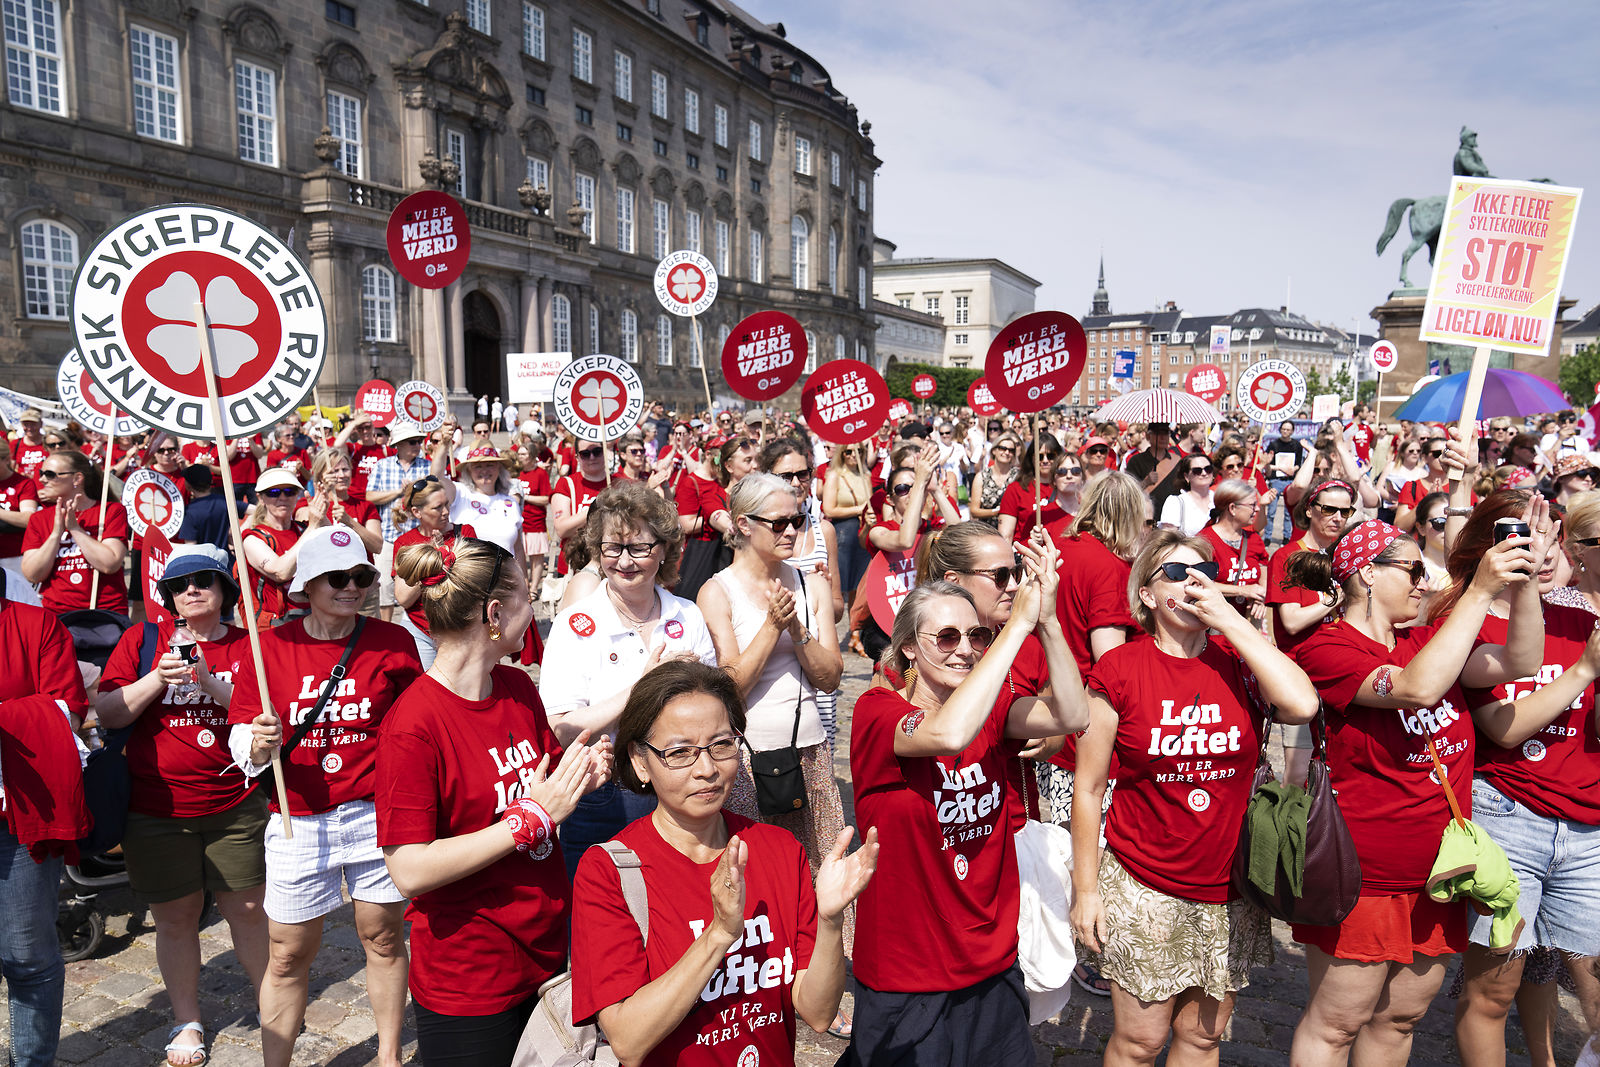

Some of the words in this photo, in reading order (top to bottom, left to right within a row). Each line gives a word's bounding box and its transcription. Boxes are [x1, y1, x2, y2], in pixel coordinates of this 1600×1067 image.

[432, 206, 448, 218] ER
[1473, 192, 1510, 216] IKKE
[1510, 195, 1554, 221] FLERE
[402, 216, 454, 242] MERE
[1469, 215, 1549, 239] SYLTEKRUKKER
[403, 234, 458, 260] VÆRD
[86, 213, 314, 312] SYGEPLEJE
[657, 252, 714, 279] SYGEPLEJE
[1461, 237, 1544, 289] STØT
[656, 283, 689, 315] DANSK
[1455, 283, 1535, 304] SYGEPLEJERSKERNE
[769, 324, 785, 337] ER
[1040, 323, 1059, 338] ER
[1434, 306, 1508, 339] LIGELØN
[1509, 316, 1543, 344] NU!
[737, 333, 792, 362] MERE
[1002, 331, 1066, 370] MERE
[1374, 350, 1392, 362] SLS
[81, 313, 203, 431] DANSK
[520, 361, 537, 370] NED
[542, 360, 561, 369] MED
[559, 356, 640, 391] SYGEPLEJE
[737, 349, 795, 378] VÆRD
[1003, 350, 1070, 388] VÆRD
[229, 331, 319, 428] RAAD
[842, 370, 858, 384] ER
[1246, 361, 1304, 393] SYGEPLEJE
[61, 370, 106, 430] DANSK
[814, 377, 869, 411] MERE
[1239, 383, 1263, 420] DANSK
[556, 395, 599, 439] DANSK
[607, 397, 641, 437] RAAD
[818, 392, 876, 425] VÆRD
[126, 471, 181, 503] SYGEPLEJE
[169, 717, 200, 728] MERE
[200, 709, 213, 718] ER
[312, 728, 325, 738] VI
[329, 727, 345, 736] ER
[332, 732, 367, 746] VÆRD
[1434, 736, 1450, 750] ER
[1540, 724, 1578, 738] ÆRD
[1155, 773, 1194, 783] MERE
[1199, 767, 1236, 782] VÆRD
[1176, 761, 1191, 773] VI
[1195, 760, 1213, 771] ER
[958, 824, 993, 843] VÆRD
[719, 1006, 737, 1025] VI
[742, 1002, 763, 1017] ER
[696, 1022, 740, 1046] MERE
